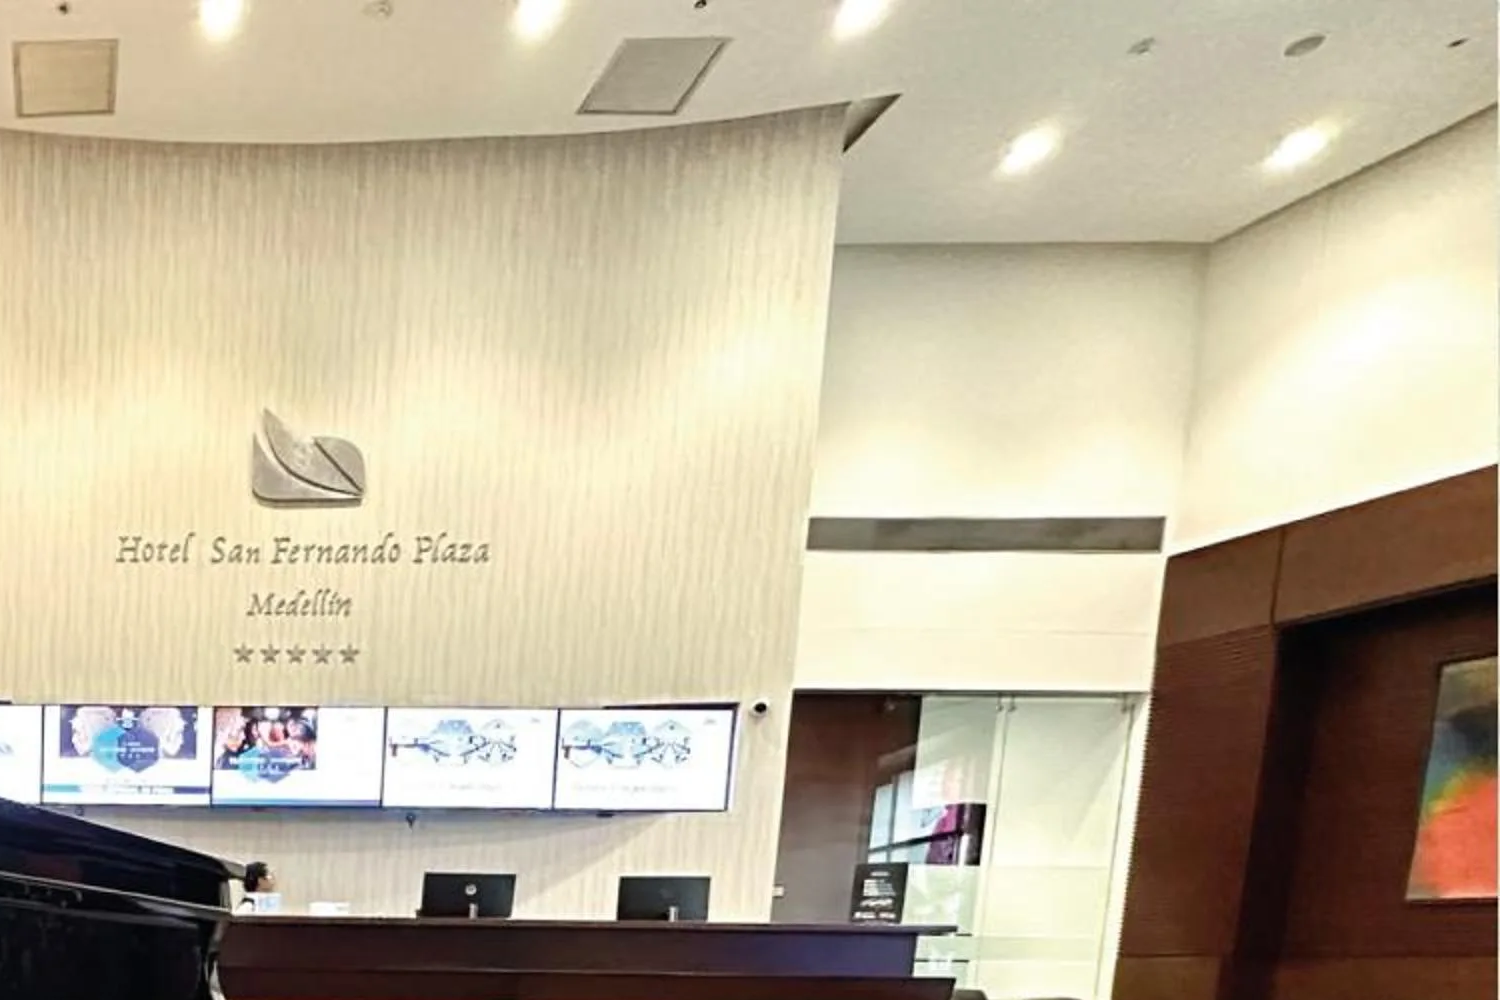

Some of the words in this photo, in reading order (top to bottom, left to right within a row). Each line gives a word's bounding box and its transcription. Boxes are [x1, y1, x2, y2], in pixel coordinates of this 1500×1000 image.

[115, 532, 196, 563] Hotel
[210, 536, 260, 564] San
[270, 532, 401, 564] Fernando
[412, 532, 490, 564] Plaza
